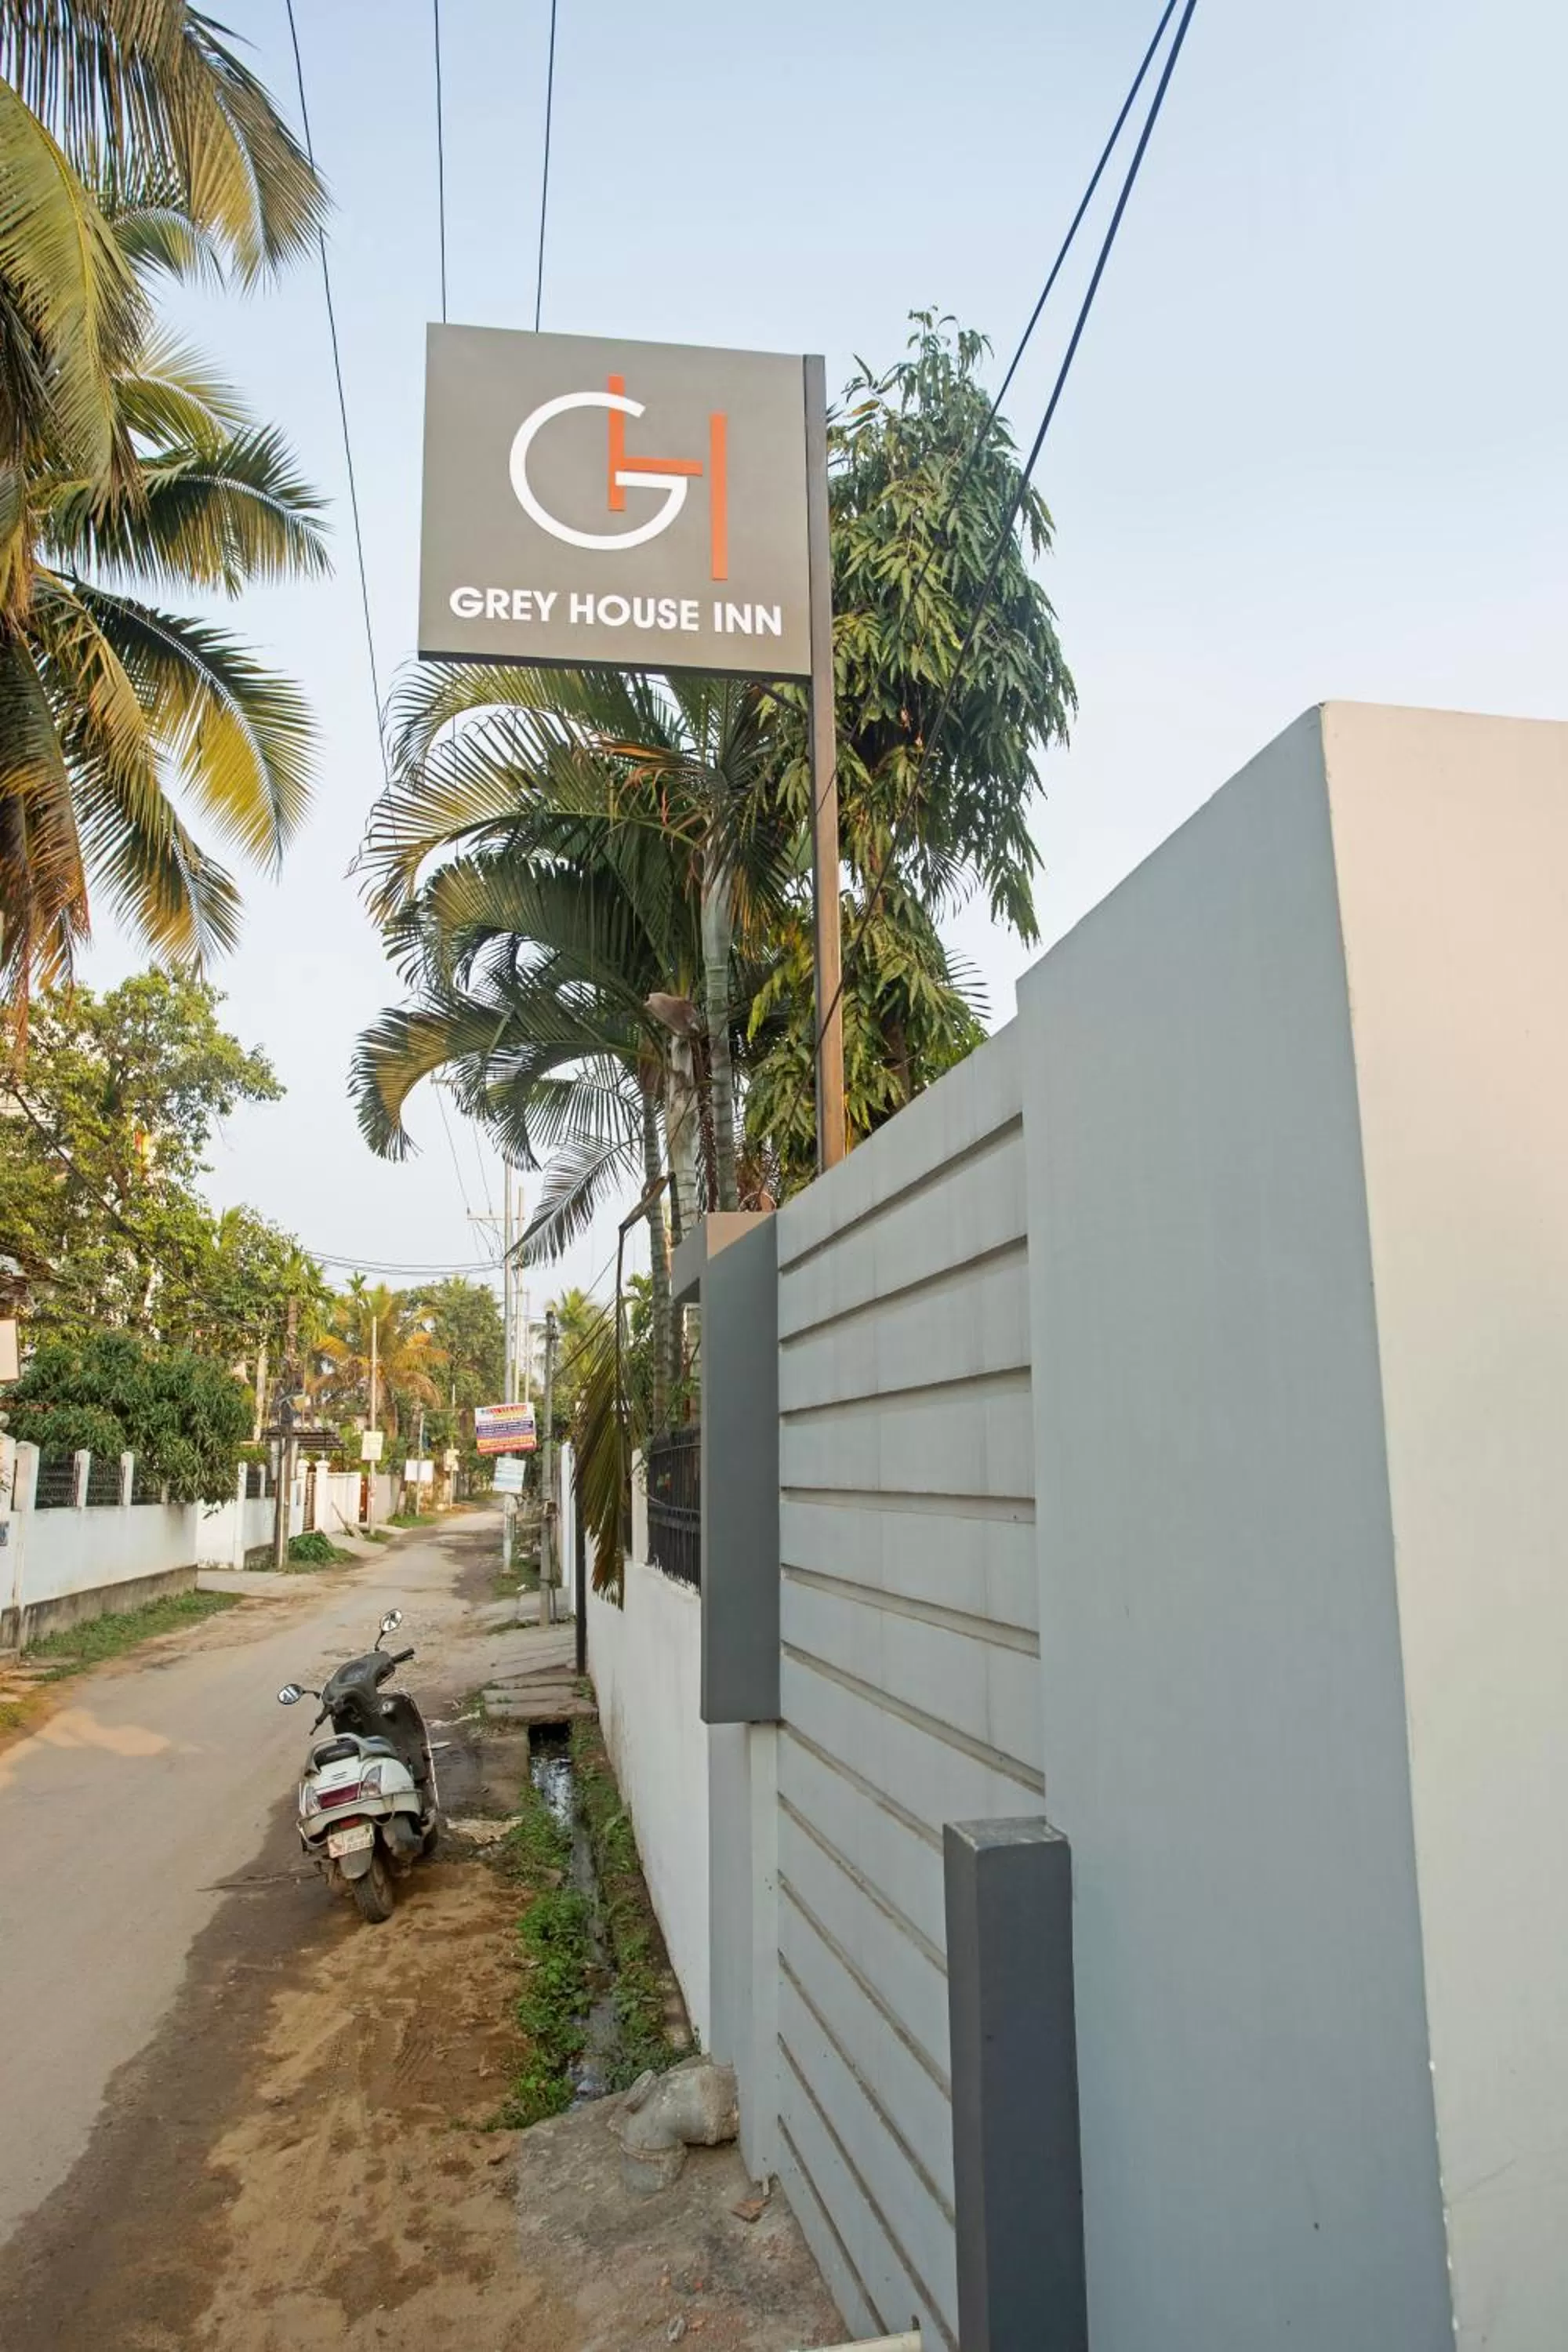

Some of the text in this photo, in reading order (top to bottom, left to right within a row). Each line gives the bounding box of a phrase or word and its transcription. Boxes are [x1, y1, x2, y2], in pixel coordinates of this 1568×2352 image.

[449, 586, 782, 636] GREY HOUSE INN
